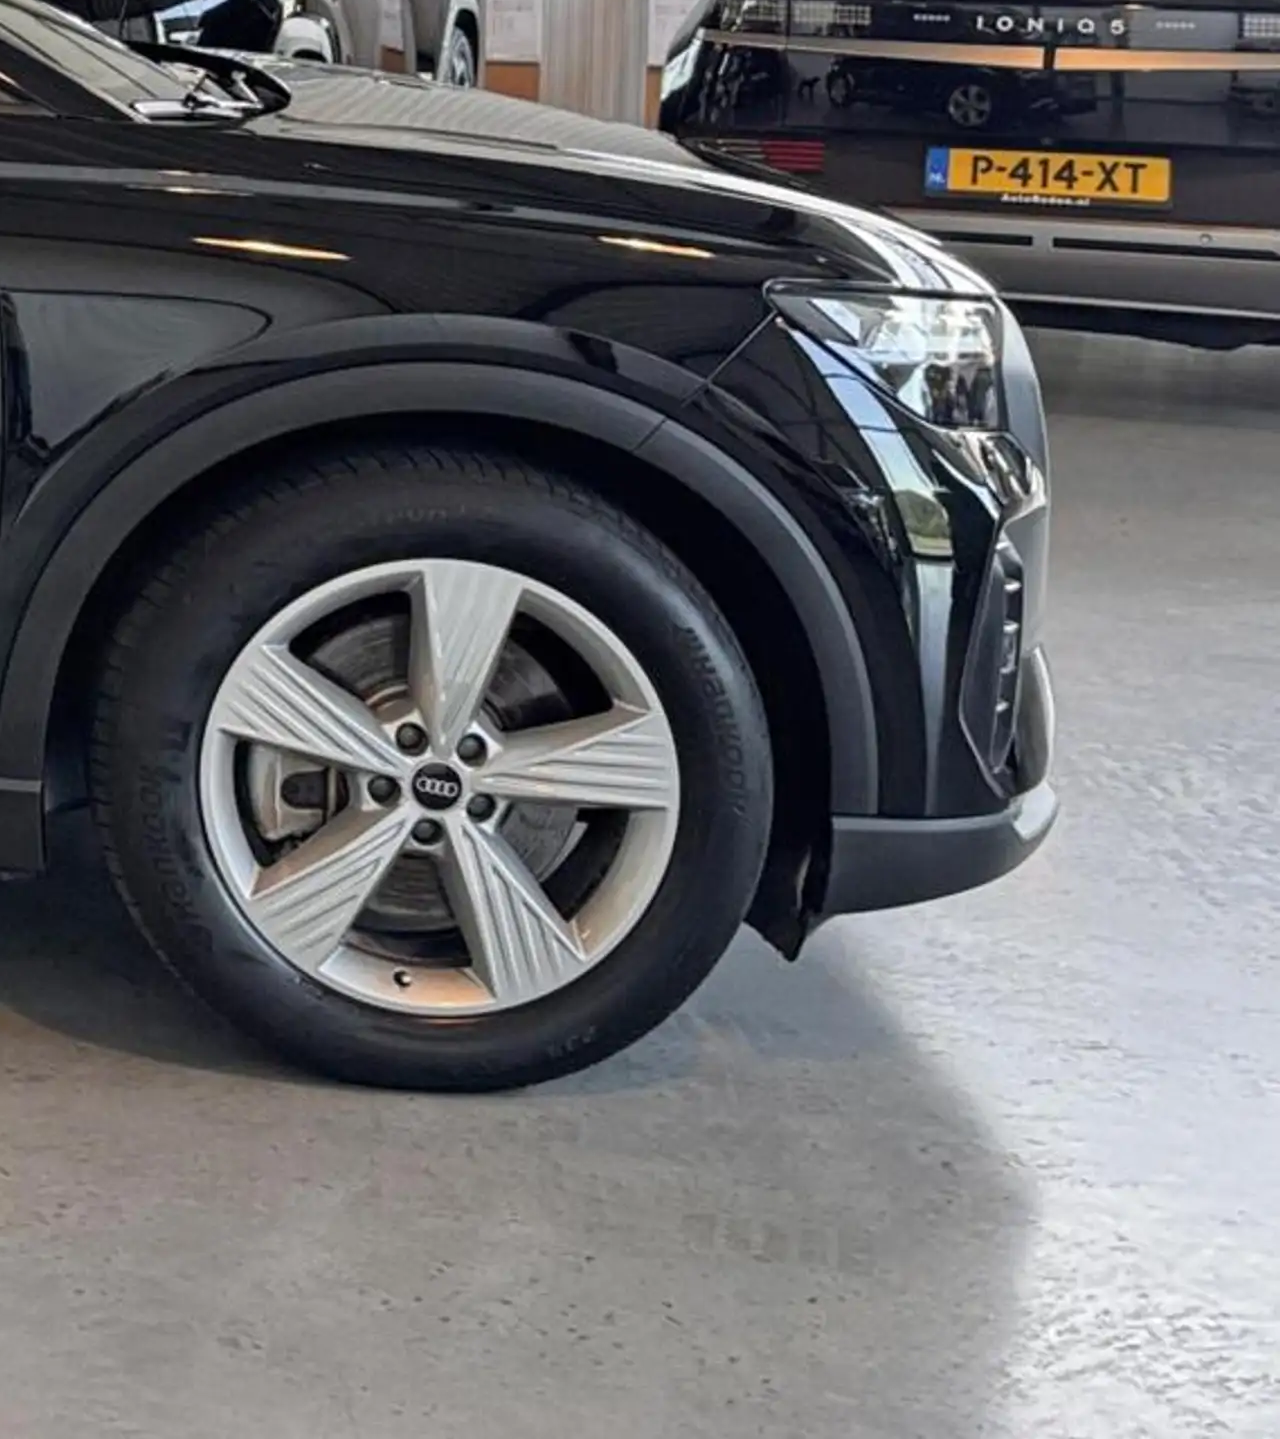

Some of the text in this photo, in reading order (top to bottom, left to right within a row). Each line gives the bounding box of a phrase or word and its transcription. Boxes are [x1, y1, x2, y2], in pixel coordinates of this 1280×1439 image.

[976, 15, 1125, 35] IONIQ 5
[971, 155, 1147, 193] P-414-XT
